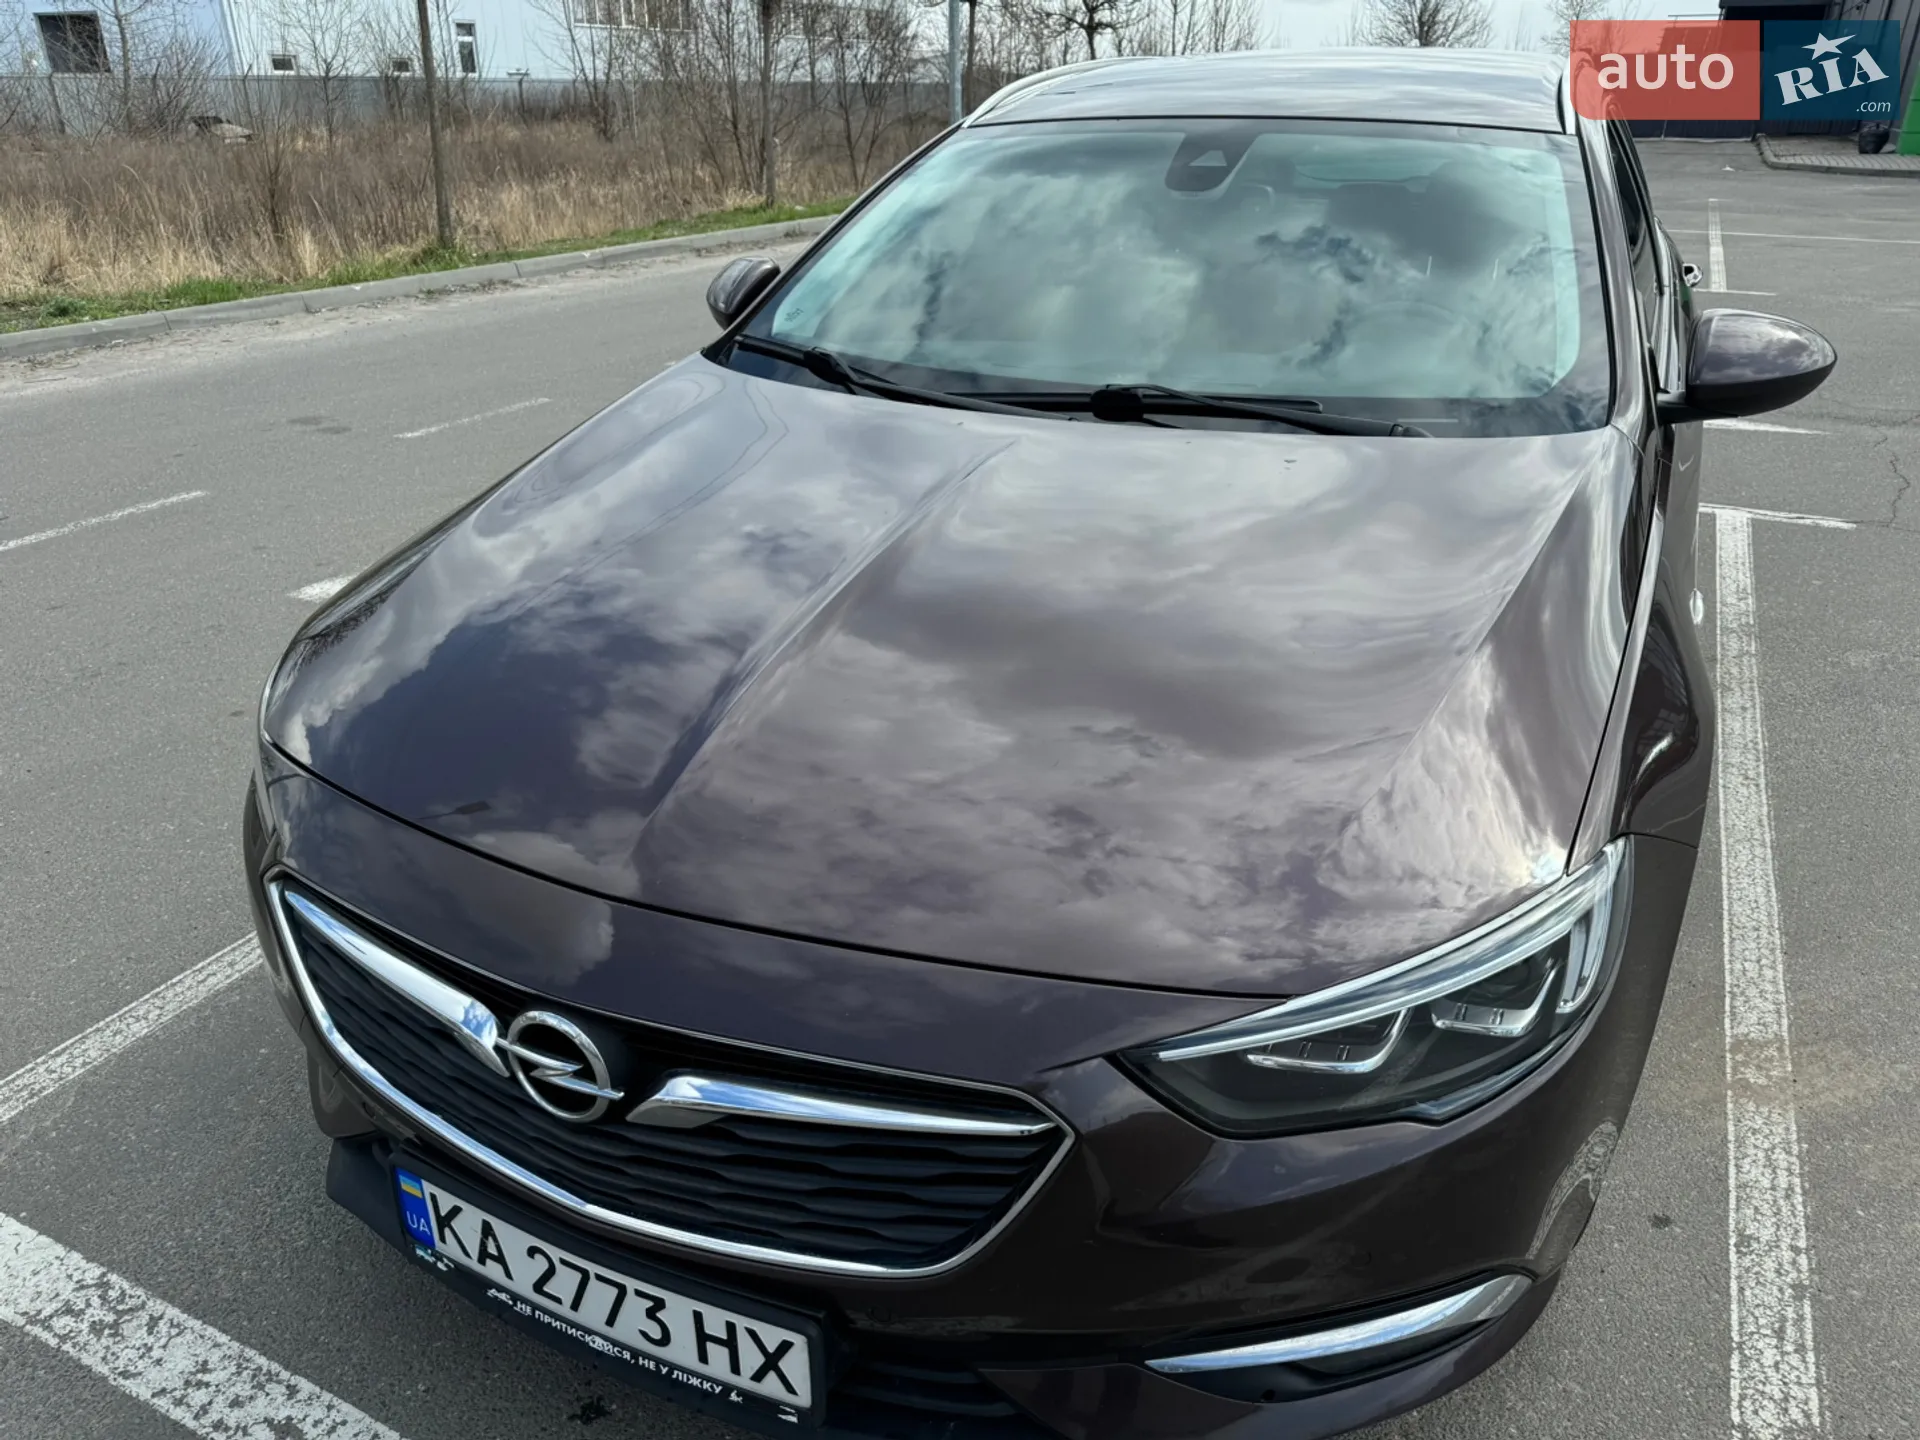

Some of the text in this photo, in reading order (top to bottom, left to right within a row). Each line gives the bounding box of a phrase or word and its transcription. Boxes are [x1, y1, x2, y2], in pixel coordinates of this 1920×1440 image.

[407, 1211, 430, 1236] UA
[430, 1192, 799, 1396] KA 2773 HX
[639, 1356, 656, 1371] НЕ
[672, 1370, 723, 1394] ЛІЖКУ
